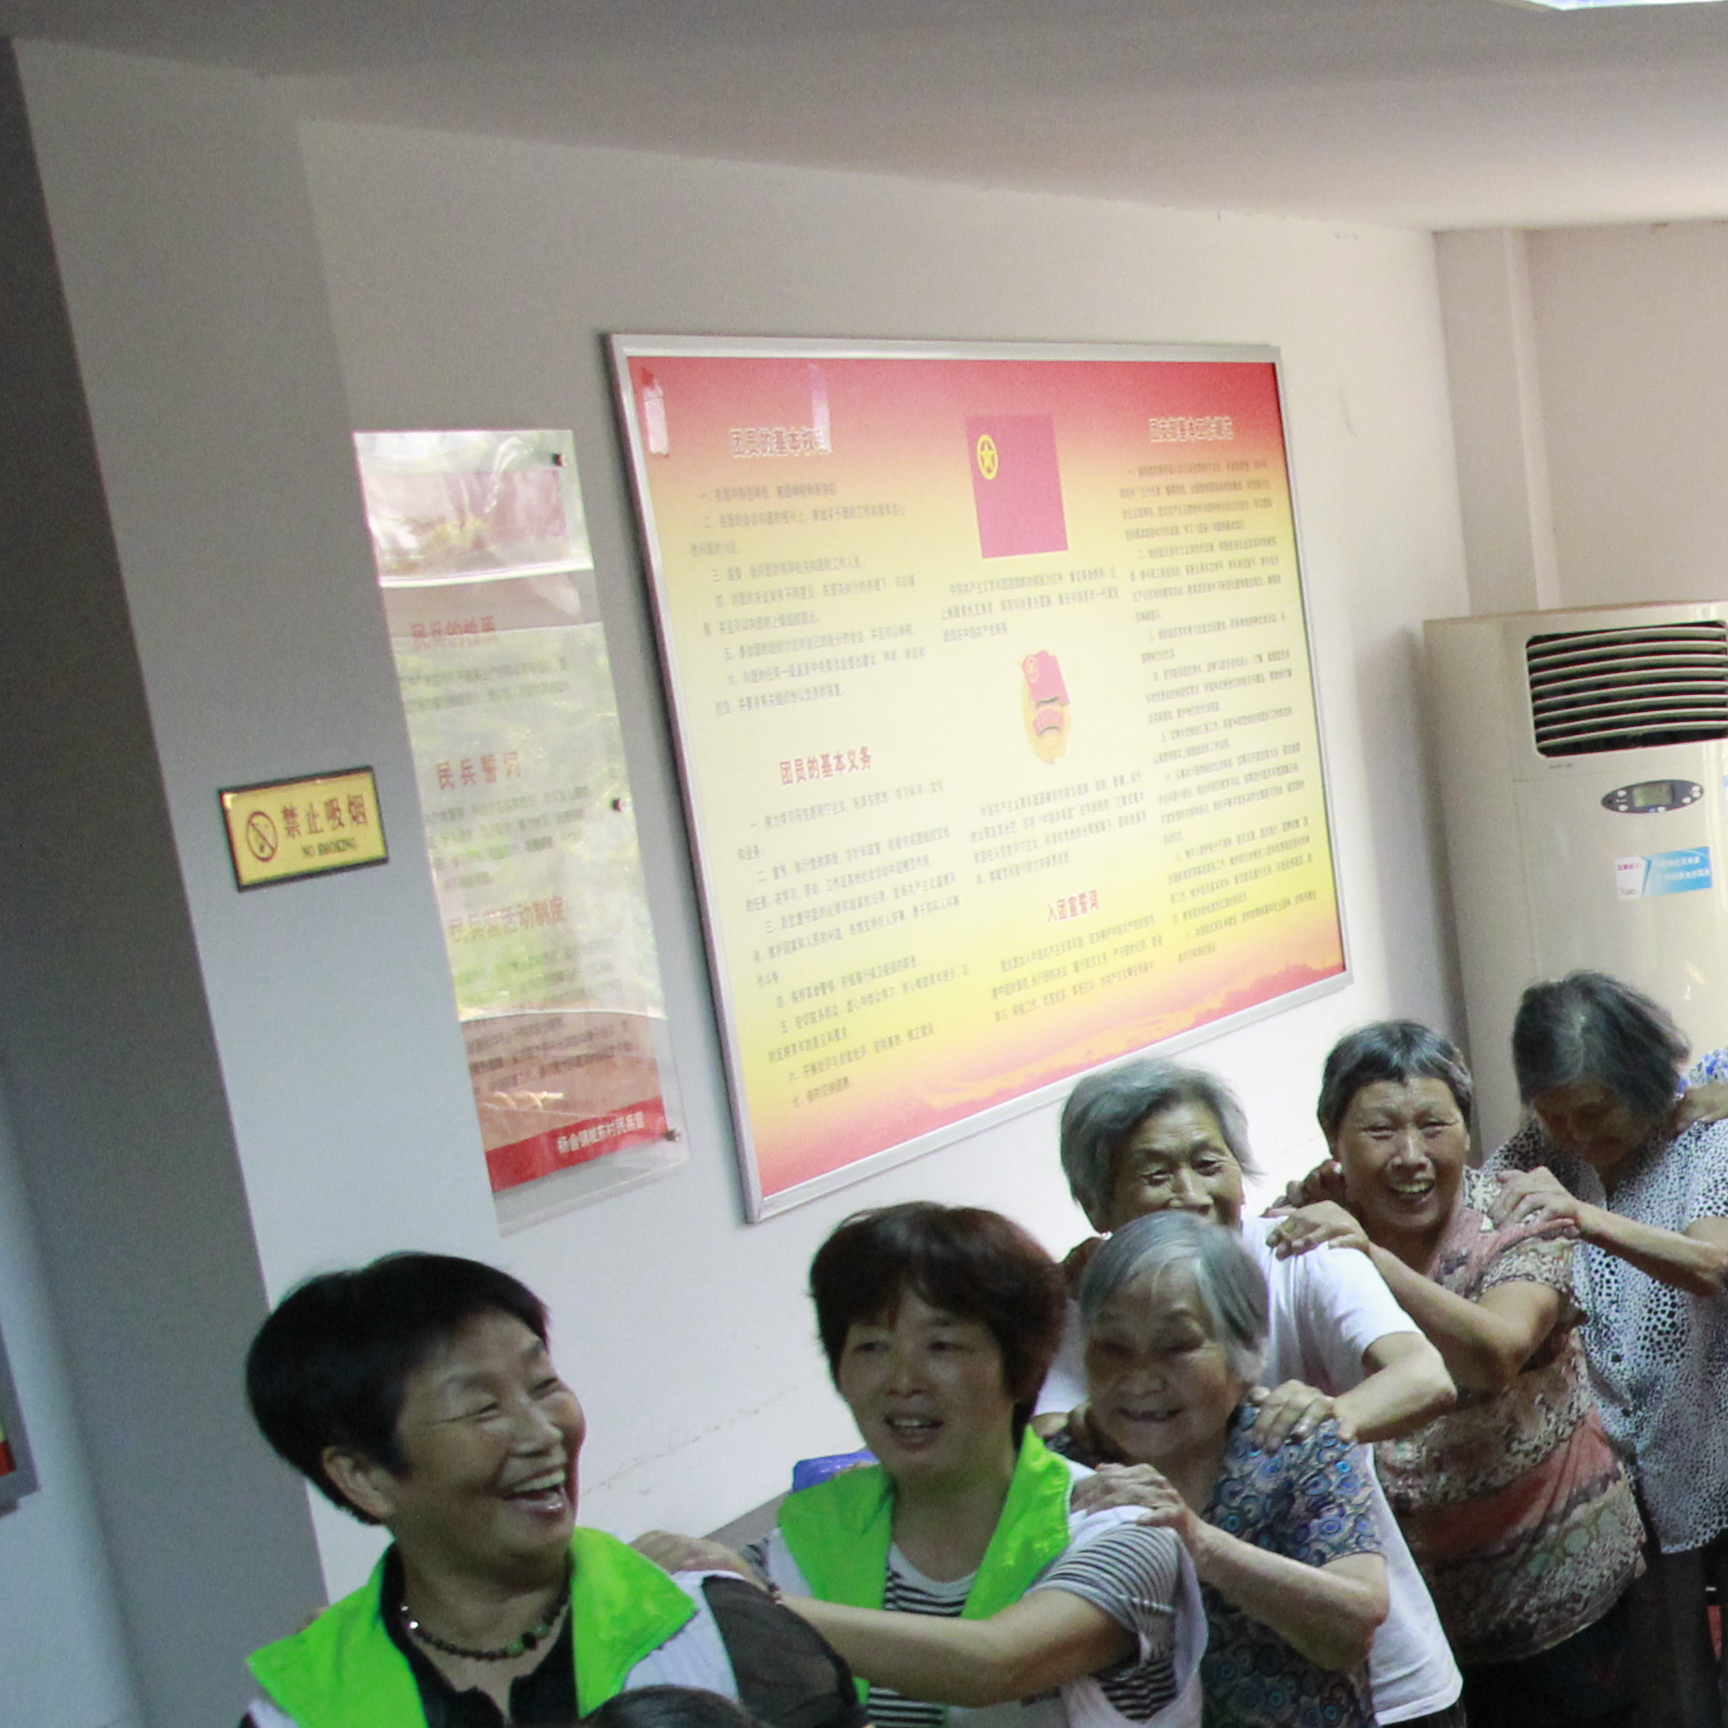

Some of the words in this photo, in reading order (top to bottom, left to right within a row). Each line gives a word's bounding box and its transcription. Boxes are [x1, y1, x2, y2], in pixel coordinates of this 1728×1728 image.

[436, 751, 521, 790] 民兵誓词
[778, 744, 873, 786] 团员的基本义务
[282, 795, 367, 840] 禁止吸烟
[1045, 887, 1099, 925] 入团宣誓词
